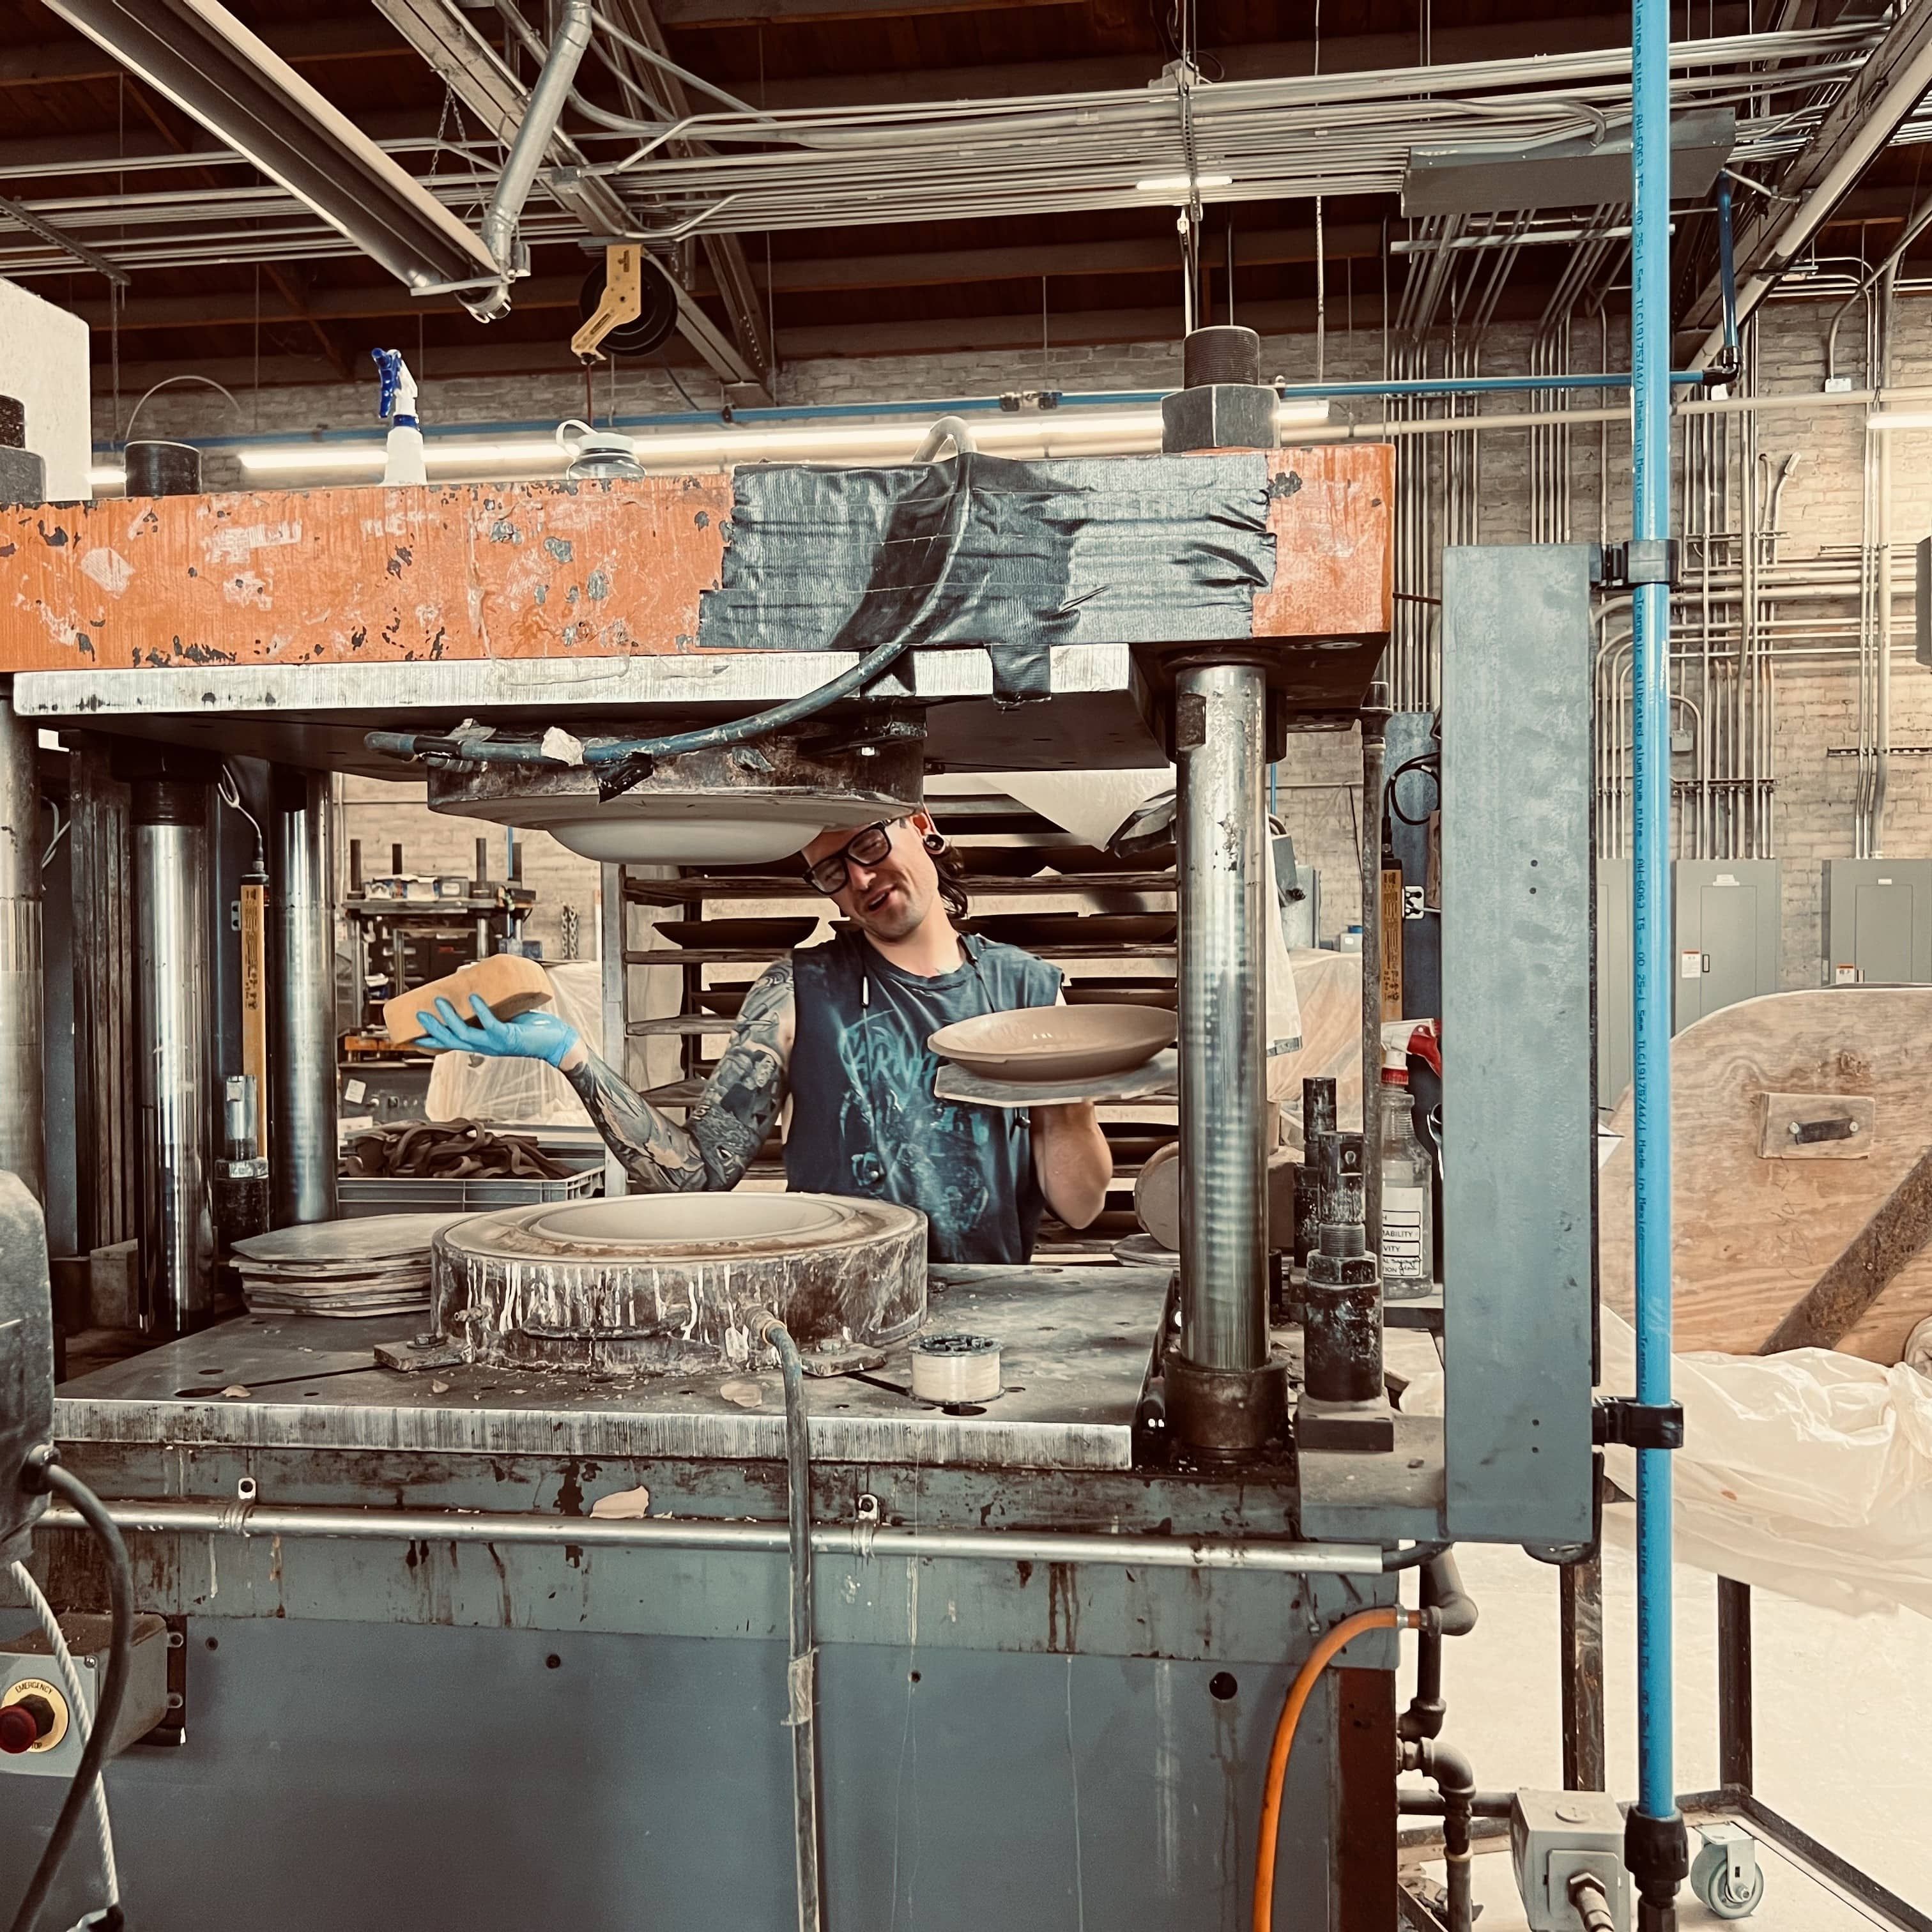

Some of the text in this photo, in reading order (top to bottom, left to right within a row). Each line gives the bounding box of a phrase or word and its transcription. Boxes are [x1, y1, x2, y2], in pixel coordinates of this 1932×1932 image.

[1636, 400, 1644, 430] Made
[1636, 439, 1644, 451] in
[1636, 457, 1644, 503] Mexico
[1636, 664, 1644, 737] calibrated
[1636, 744, 1644, 802] aluminum
[1636, 858, 1645, 909] AW-6063
[1637, 1039, 1646, 1131] TLC19175744/1
[1637, 1139, 1646, 1169] Made
[1638, 1177, 1646, 1191] in
[1638, 1197, 1647, 1240] Mexico
[15, 1682, 52, 1694] EMERGENCY
